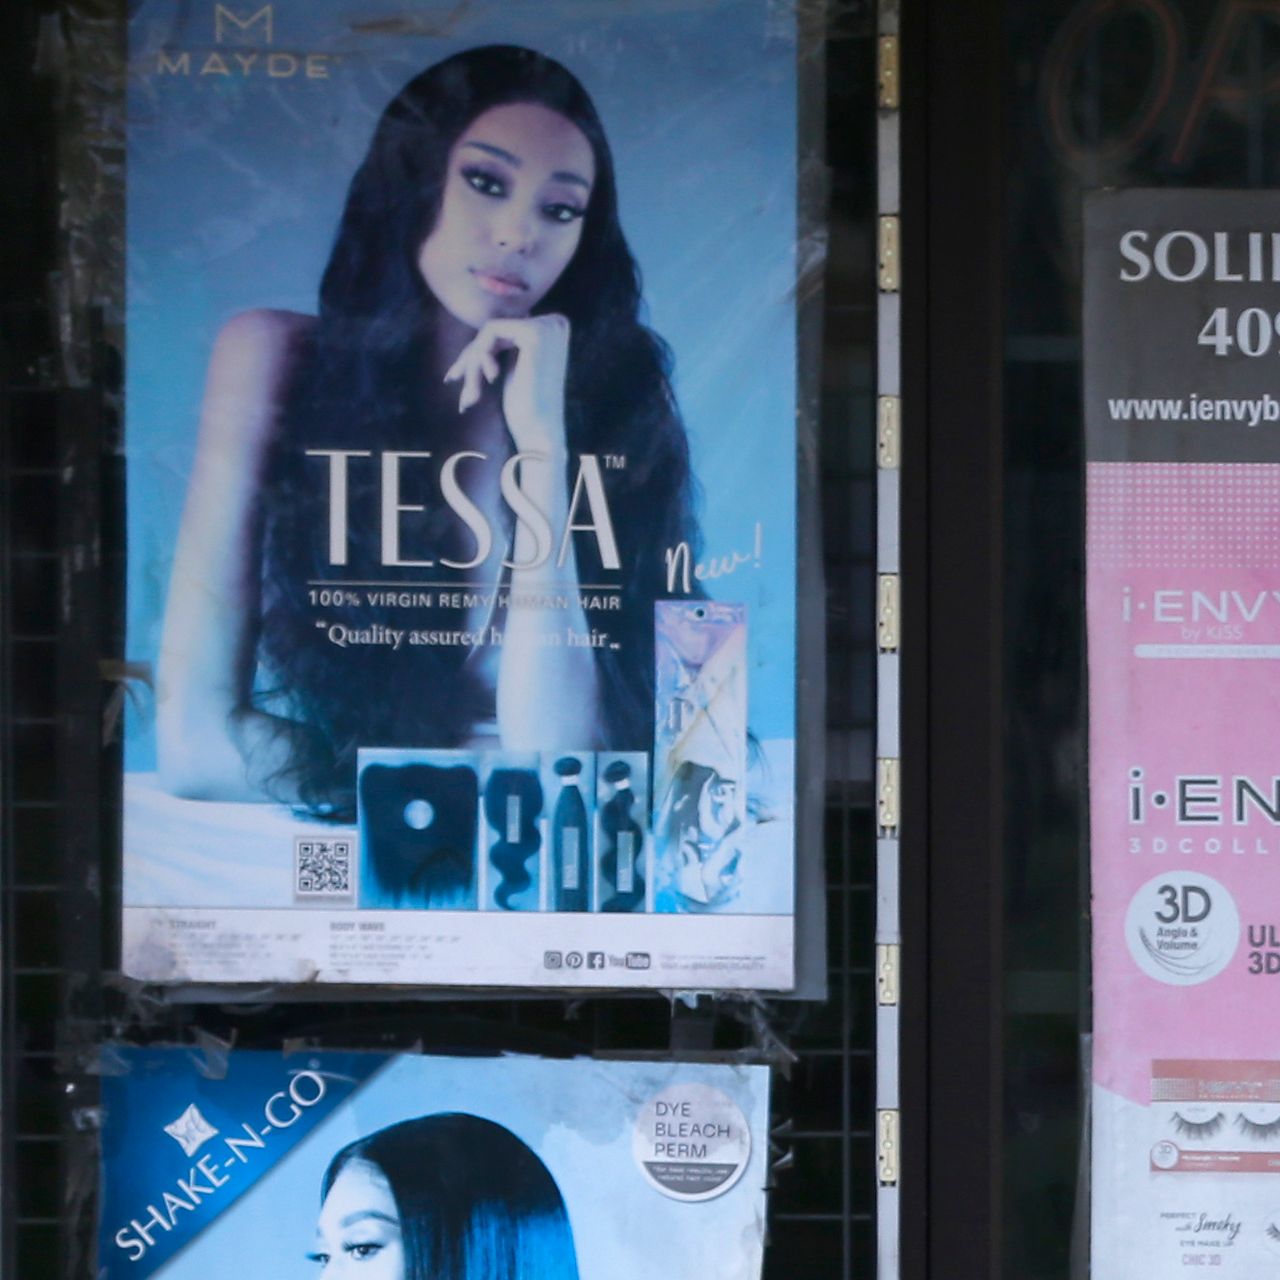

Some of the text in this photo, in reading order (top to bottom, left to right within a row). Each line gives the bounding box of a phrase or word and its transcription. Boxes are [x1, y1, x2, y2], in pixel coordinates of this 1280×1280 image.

[157, 55, 331, 78] MAYDE
[664, 521, 763, 594] New!
[307, 590, 361, 606] 100%
[366, 592, 432, 609] VIRGIN
[438, 593, 487, 609] REMY
[577, 596, 622, 611] HAIR
[1154, 884, 1213, 924] 3D
[655, 1100, 691, 1117] DYE
[654, 1122, 731, 1139] BLEACH
[654, 1142, 707, 1158] PERM
[114, 1068, 330, 1262] SHAKE-N-GO
